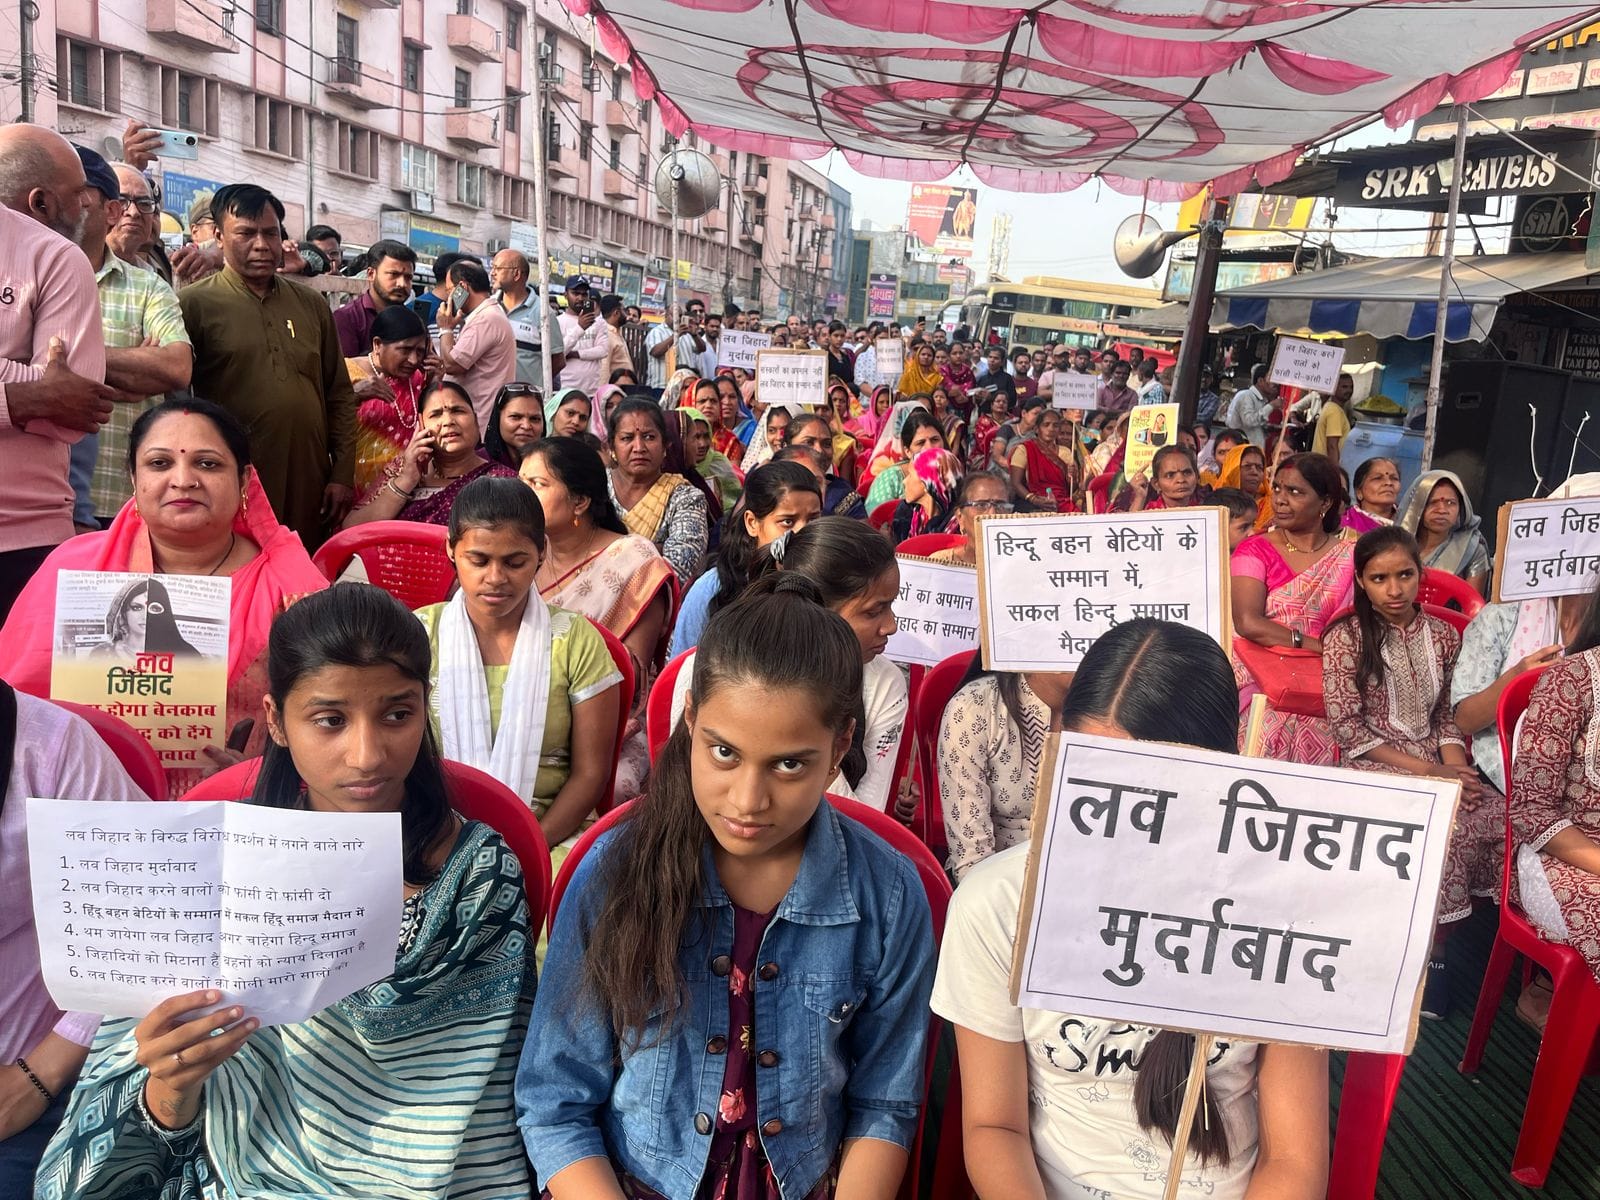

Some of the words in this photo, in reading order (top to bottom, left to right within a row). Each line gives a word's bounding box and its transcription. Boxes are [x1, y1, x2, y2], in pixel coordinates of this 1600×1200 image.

[1362, 165, 1436, 199] SRK
[1440, 152, 1558, 193] RAVELS
[723, 334, 736, 344] लव
[742, 335, 768, 347] जिहाद
[1567, 346, 1600, 358] RAILWA
[728, 351, 756, 362] मुर्दाबा
[1565, 358, 1585, 369] TAXI
[1587, 359, 1600, 370] BO
[1513, 517, 1548, 538] लव
[1561, 508, 1600, 534] जिह
[995, 531, 1041, 561] हिन्दू
[1050, 535, 1092, 554] बहन
[1105, 526, 1164, 552] बेटियों
[1176, 524, 1198, 550] के
[1047, 569, 1109, 588] सम्मान
[1123, 562, 1143, 589] में,
[916, 589, 931, 604] का
[936, 592, 974, 610] अपमान
[1006, 604, 1060, 622] सकल
[1074, 598, 1119, 627] हिन्दू
[1130, 603, 1190, 621] समाज
[896, 616, 920, 632] हाद
[924, 620, 938, 635] का
[942, 622, 977, 640] सम्मान
[1058, 630, 1098, 655] मैदा
[136, 653, 175, 673] लव
[107, 666, 174, 696] जिहाद
[153, 701, 216, 716] बेनकाब
[158, 725, 181, 740] को
[187, 724, 213, 740] देंगे
[66, 829, 87, 842] लव
[92, 828, 130, 845] जिहाद
[134, 828, 146, 843] के
[152, 828, 188, 844] विरुद्ध
[194, 828, 229, 843] विरोध
[233, 832, 264, 848] प्रदर्शन
[269, 834, 278, 848] में
[282, 836, 310, 850] लगने
[314, 838, 338, 851] वाले
[342, 840, 365, 851] नारे
[1067, 777, 1178, 844] लव
[1217, 779, 1424, 880] जिहाद
[60, 856, 74, 869] 1.
[80, 859, 100, 871] लव
[105, 858, 144, 875] जिहाद
[148, 858, 198, 876] मुर्दाबाद
[61, 878, 76, 892] 2.
[81, 882, 102, 895] लव
[106, 881, 143, 899] जिहाद
[148, 882, 176, 897] करने
[181, 882, 213, 896] वालों
[218, 882, 230, 896] को
[234, 886, 261, 900] फांसी
[265, 888, 278, 901] दो
[282, 888, 314, 901] फांसी
[318, 888, 332, 900] दो
[62, 901, 76, 914] 3.
[82, 904, 104, 920] हिंदू
[105, 908, 130, 922] बहन
[134, 906, 166, 920] बेटियों
[170, 907, 180, 920] के
[184, 910, 222, 920] सम्मान
[224, 907, 234, 919] में
[234, 912, 260, 924] सकल
[264, 912, 284, 927] हिंदू
[286, 914, 318, 924] समाज
[323, 910, 352, 922] मैदान
[356, 907, 366, 918] में
[64, 923, 79, 936] 4.
[108, 928, 147, 942] जायेगा
[150, 932, 170, 943] लव
[175, 929, 214, 947] जिहाद
[219, 932, 243, 944] अगर
[246, 932, 284, 948] चाहेगा
[289, 932, 317, 946] हिन्दू
[320, 928, 356, 941] समाज
[1098, 898, 1352, 992] मुर्दाबाद
[66, 944, 81, 958] 5.
[86, 946, 140, 964] जिहादियों
[145, 950, 160, 964] को
[164, 952, 206, 967] मिटाना
[211, 951, 220, 968] है
[256, 953, 272, 968] को
[277, 954, 306, 966] न्याय
[312, 946, 354, 961] दिलाना
[69, 965, 84, 979] 6.
[88, 970, 107, 982] लव
[111, 970, 146, 986] जिहाद
[150, 974, 176, 988] करने
[182, 975, 212, 990] वालों
[232, 976, 264, 990] गोली
